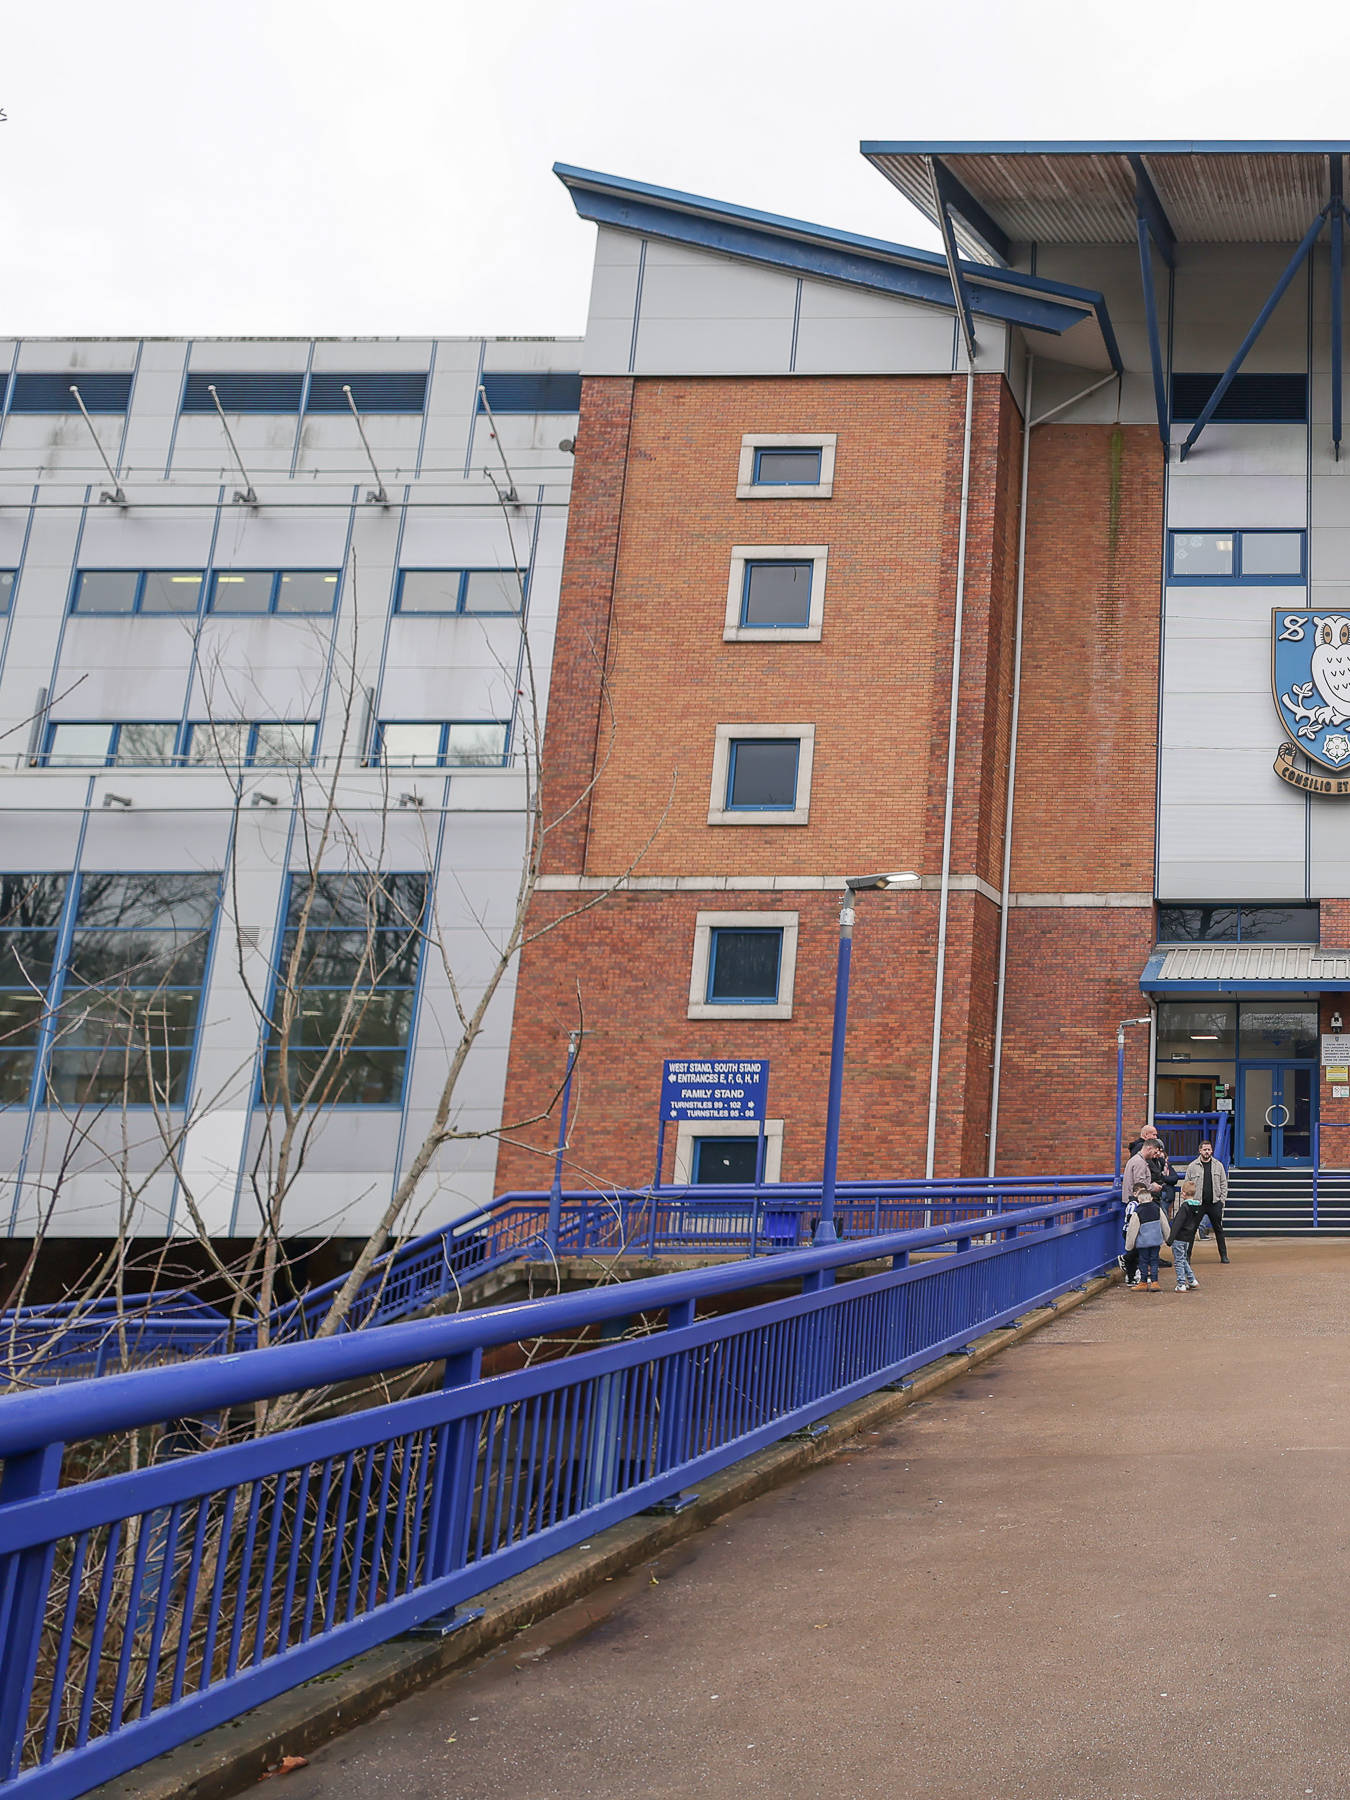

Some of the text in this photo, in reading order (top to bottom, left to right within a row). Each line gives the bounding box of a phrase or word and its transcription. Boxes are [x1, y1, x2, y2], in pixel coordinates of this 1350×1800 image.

[1278, 615, 1309, 642] S
[1281, 767, 1332, 792] CONSILIO
[1337, 781, 1349, 792] ET
[668, 1063, 761, 1073] WEST STAND, SOUTH STAND
[677, 1073, 718, 1083] ENTRANCES
[719, 1074, 727, 1084] E,
[728, 1074, 734, 1084] F,
[735, 1074, 743, 1084] G,
[681, 1089, 744, 1098] FAMILY STAND
[670, 1101, 712, 1109] TURNSTILES
